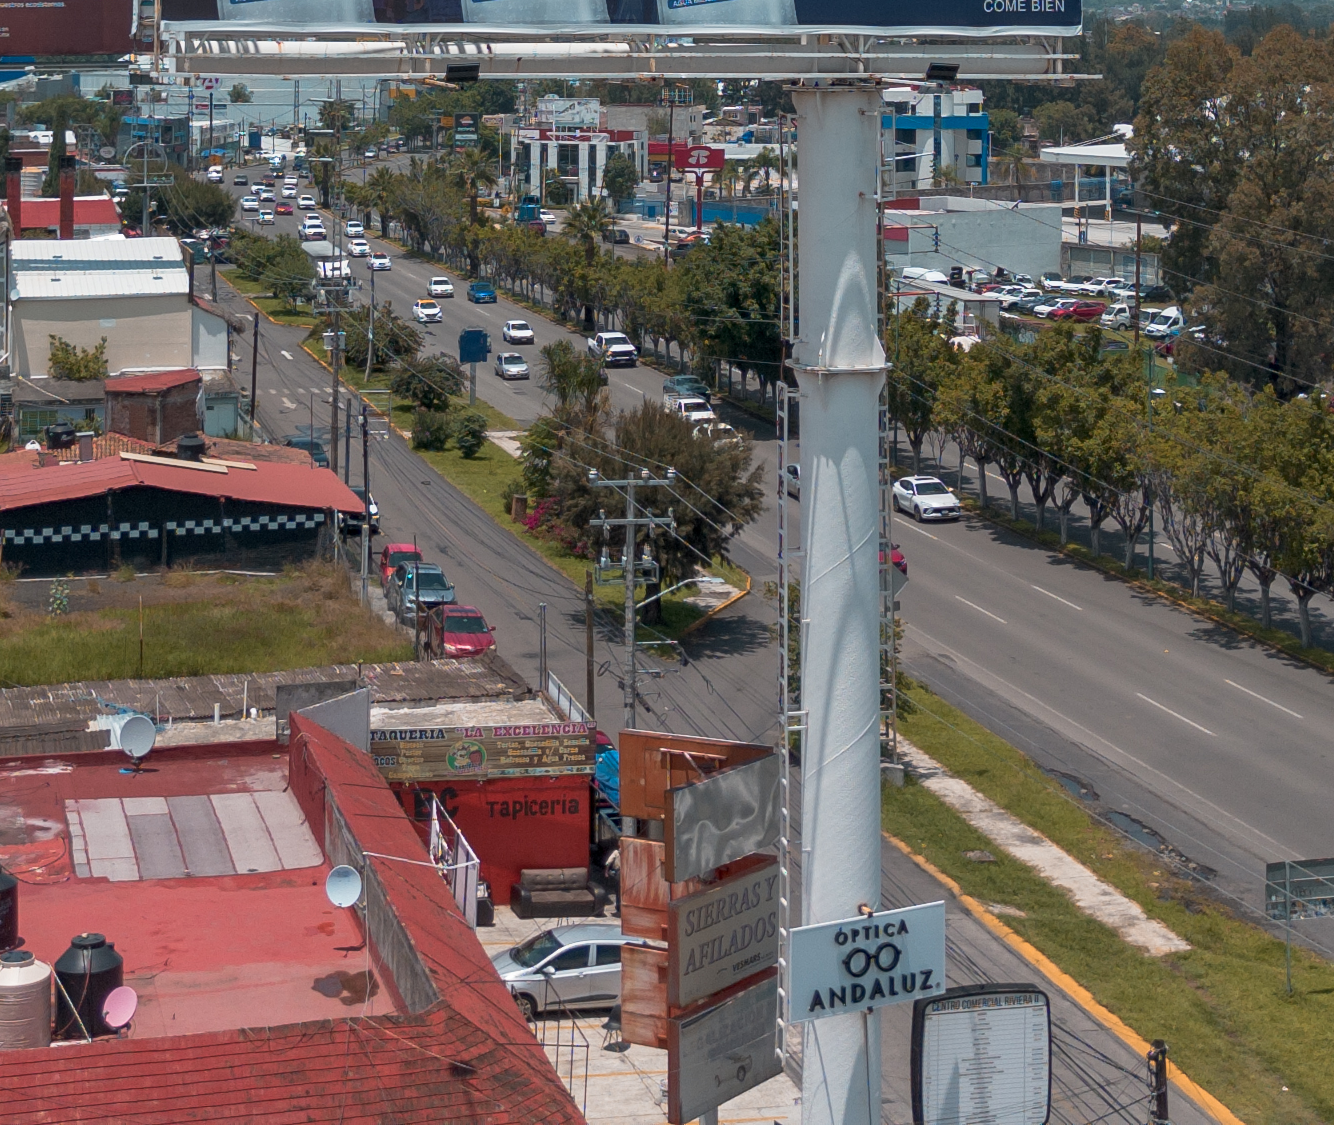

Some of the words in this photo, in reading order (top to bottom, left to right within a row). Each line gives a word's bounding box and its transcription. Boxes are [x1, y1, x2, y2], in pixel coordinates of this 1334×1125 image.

[983, 0, 1027, 13] COME
[1031, 0, 1065, 13] BIEN
[684, 881, 762, 937] SIERRAS
[764, 874, 778, 902] Y
[683, 911, 777, 976] AFILADOS
[834, 918, 909, 946] ÓPTICA
[808, 968, 934, 1013] ANDALUZ
[931, 999, 961, 1012] CENTRO
[961, 996, 1003, 1010] COMERCIAL
[1004, 994, 1033, 1006] RIVIERA
